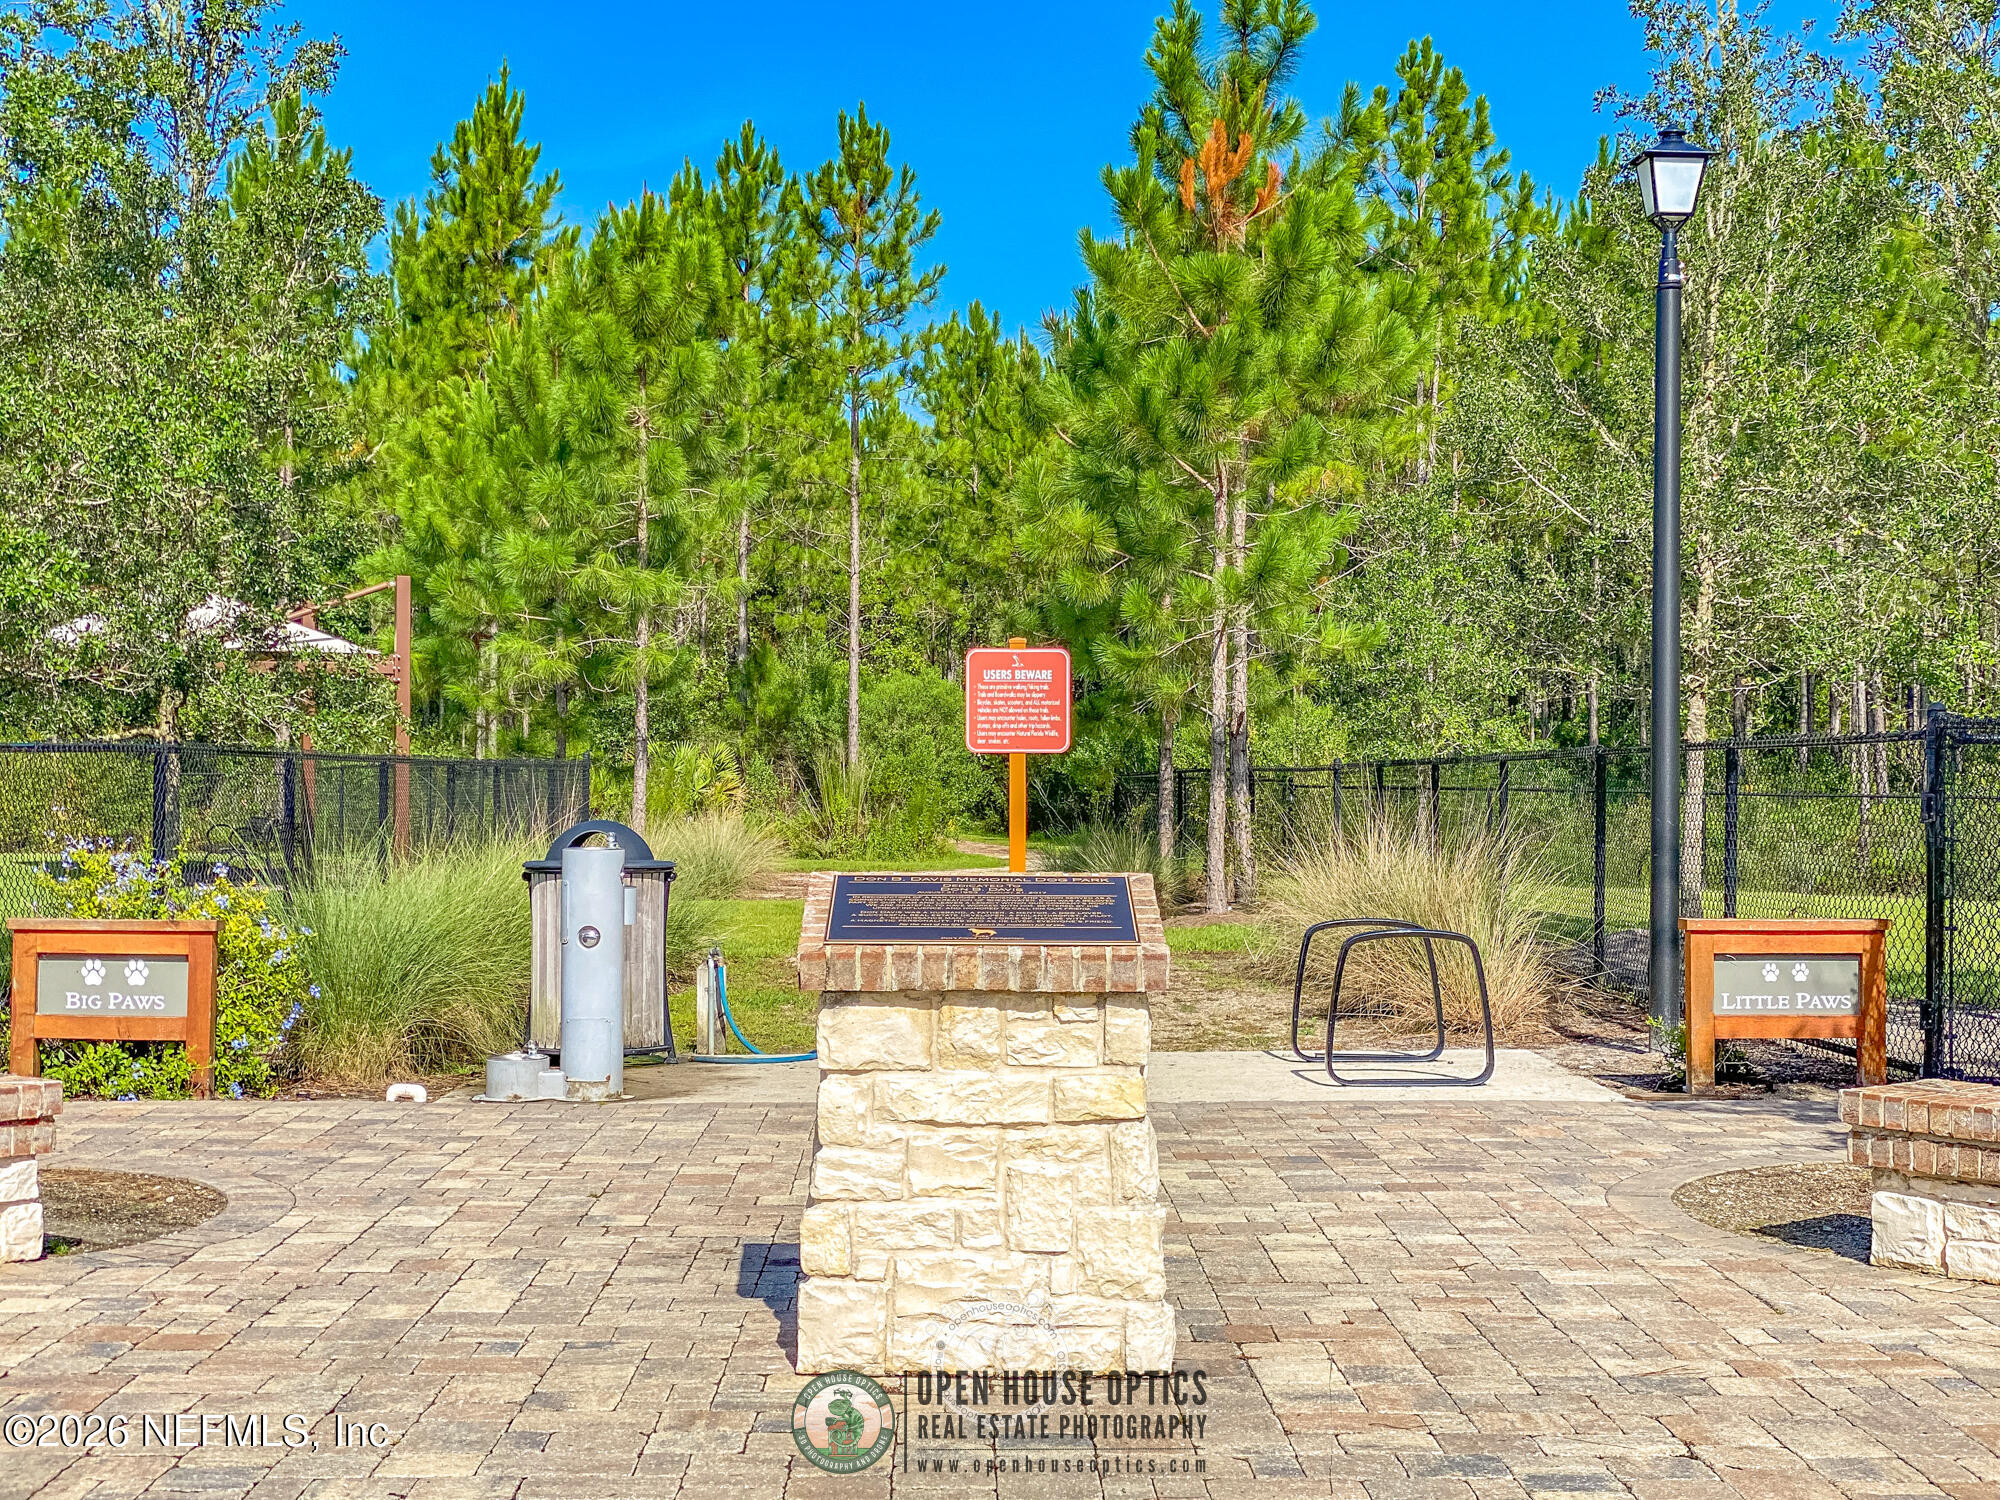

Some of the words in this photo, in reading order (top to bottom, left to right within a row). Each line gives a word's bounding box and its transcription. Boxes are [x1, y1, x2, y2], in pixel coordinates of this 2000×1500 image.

[983, 669, 1012, 680] USERS
[1015, 669, 1053, 680] BEWARE
[65, 992, 102, 1010] BIG
[108, 992, 165, 1010] PAWS
[1721, 993, 1790, 1010] LITTLE
[1795, 993, 1852, 1010] PAWS
